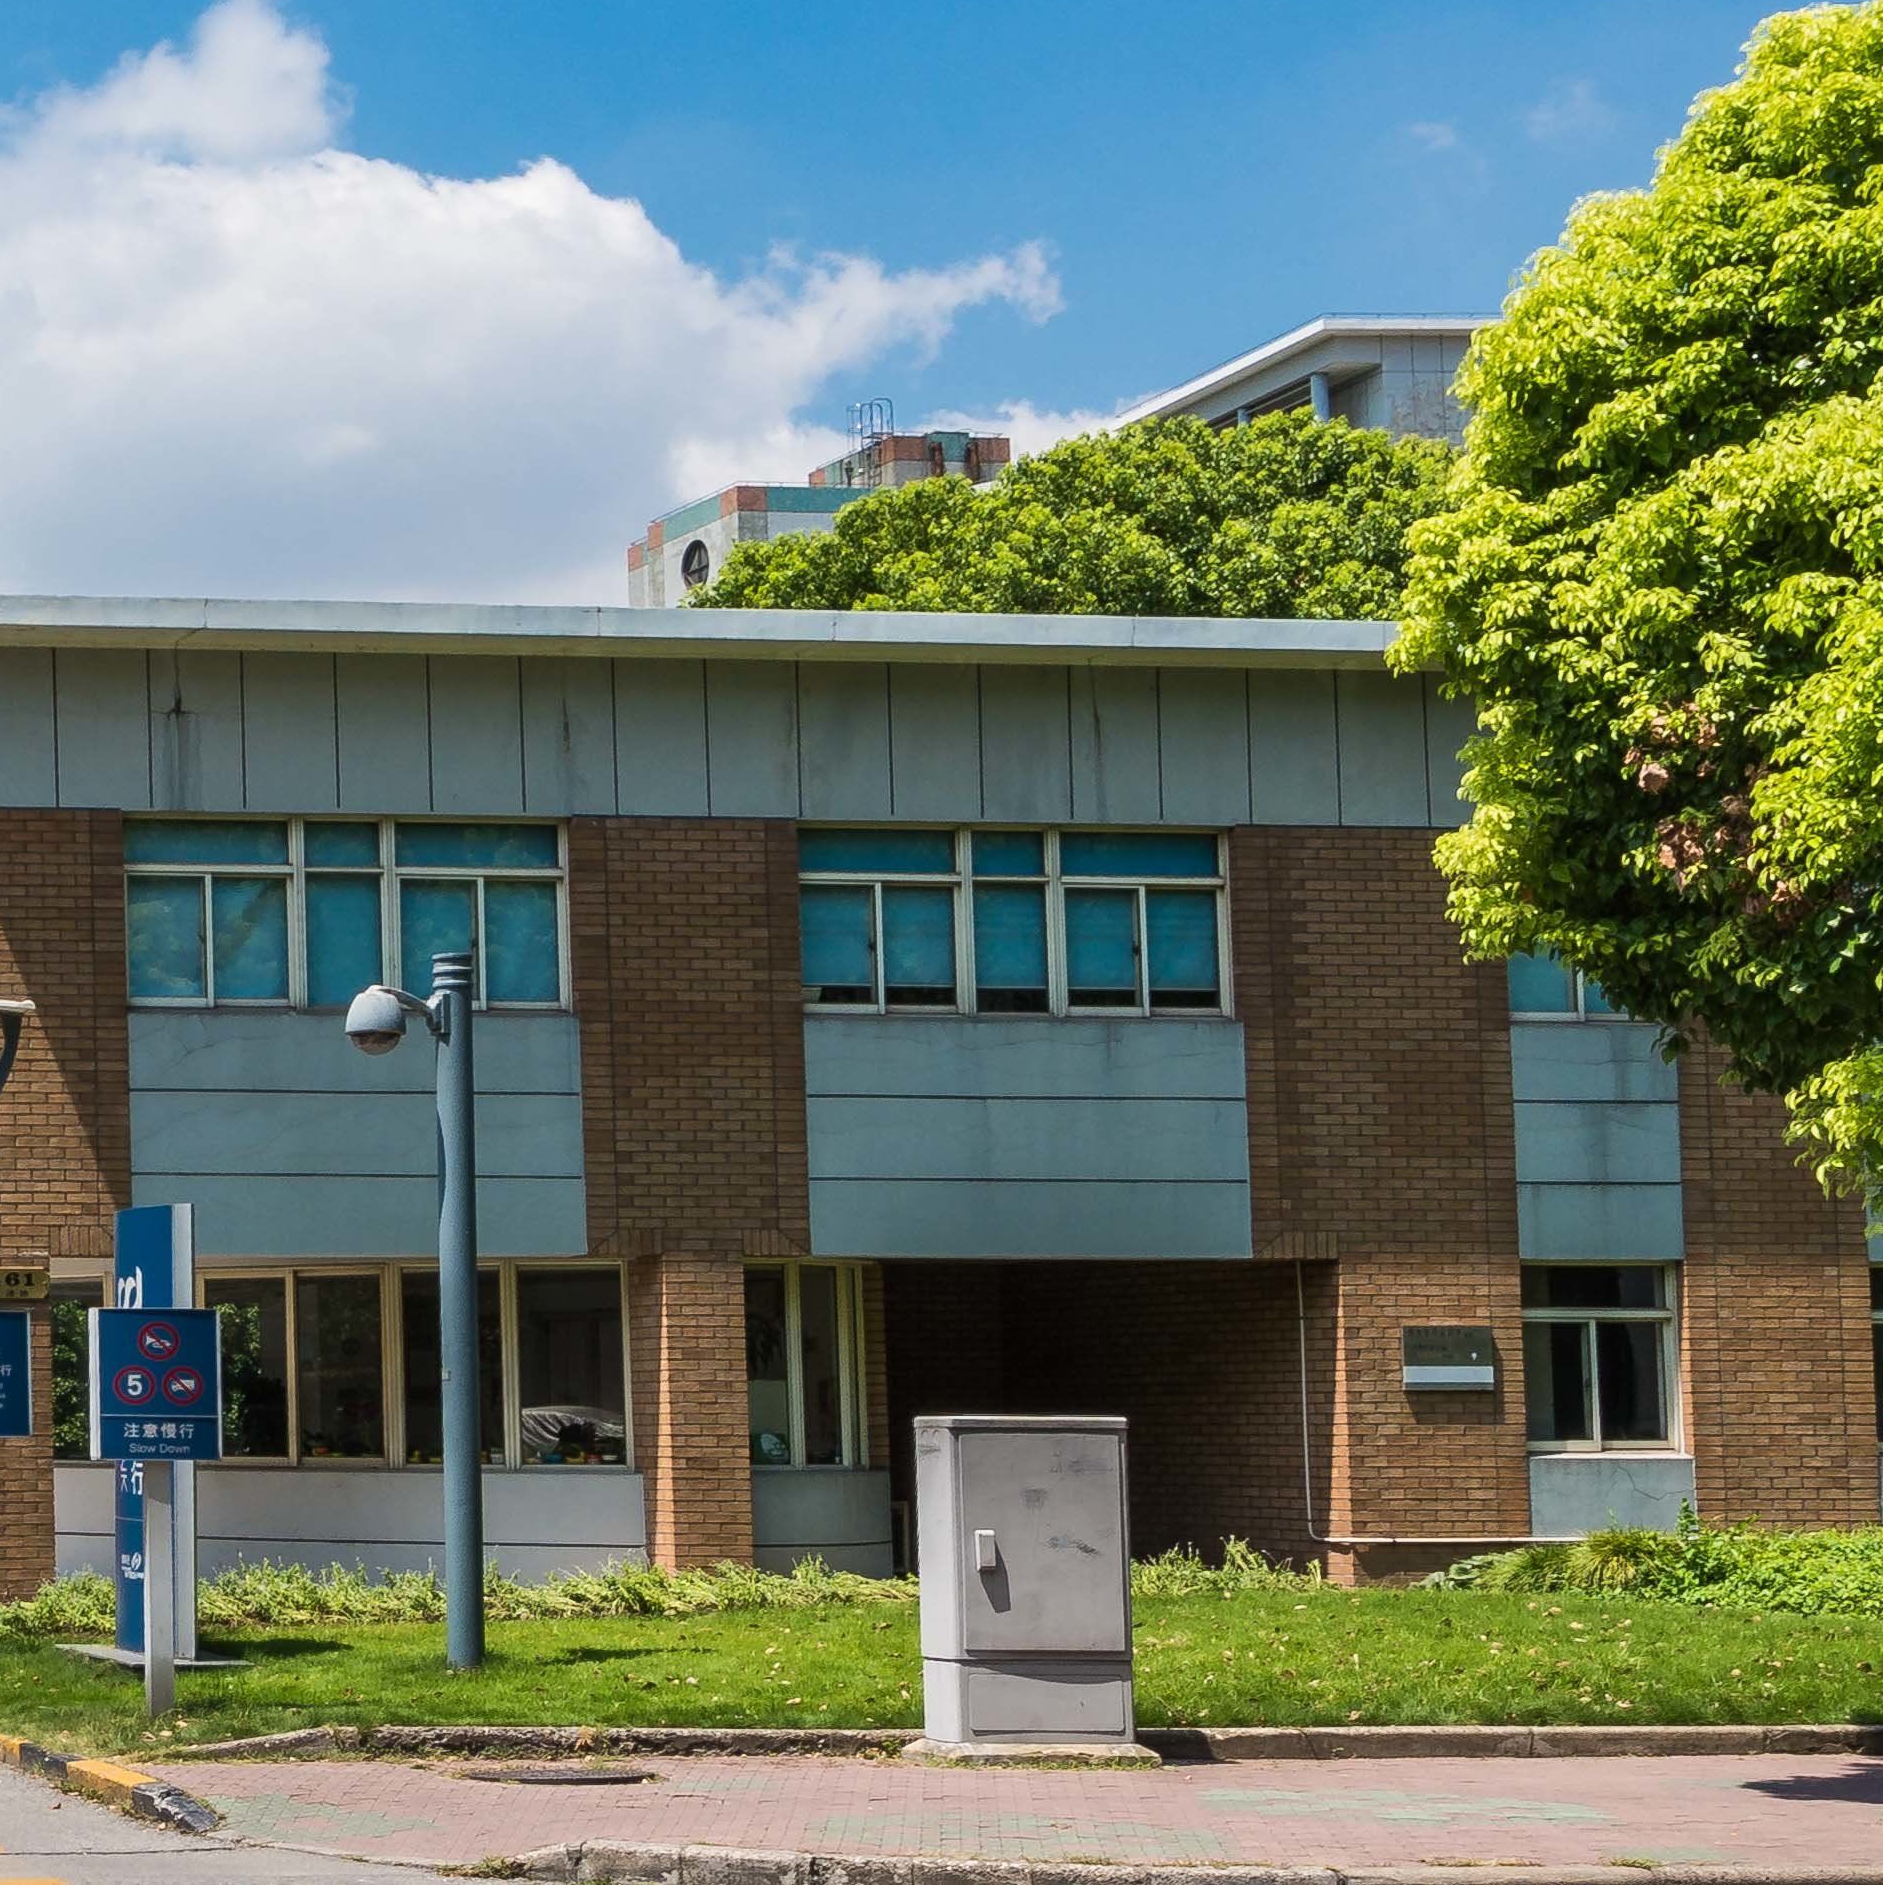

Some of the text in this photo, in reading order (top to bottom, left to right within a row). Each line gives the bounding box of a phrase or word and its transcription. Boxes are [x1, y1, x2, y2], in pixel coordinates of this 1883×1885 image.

[127, 1375, 142, 1396] 5
[123, 1422, 195, 1440] 注意慢行
[129, 1442, 191, 1454] Slow Down
